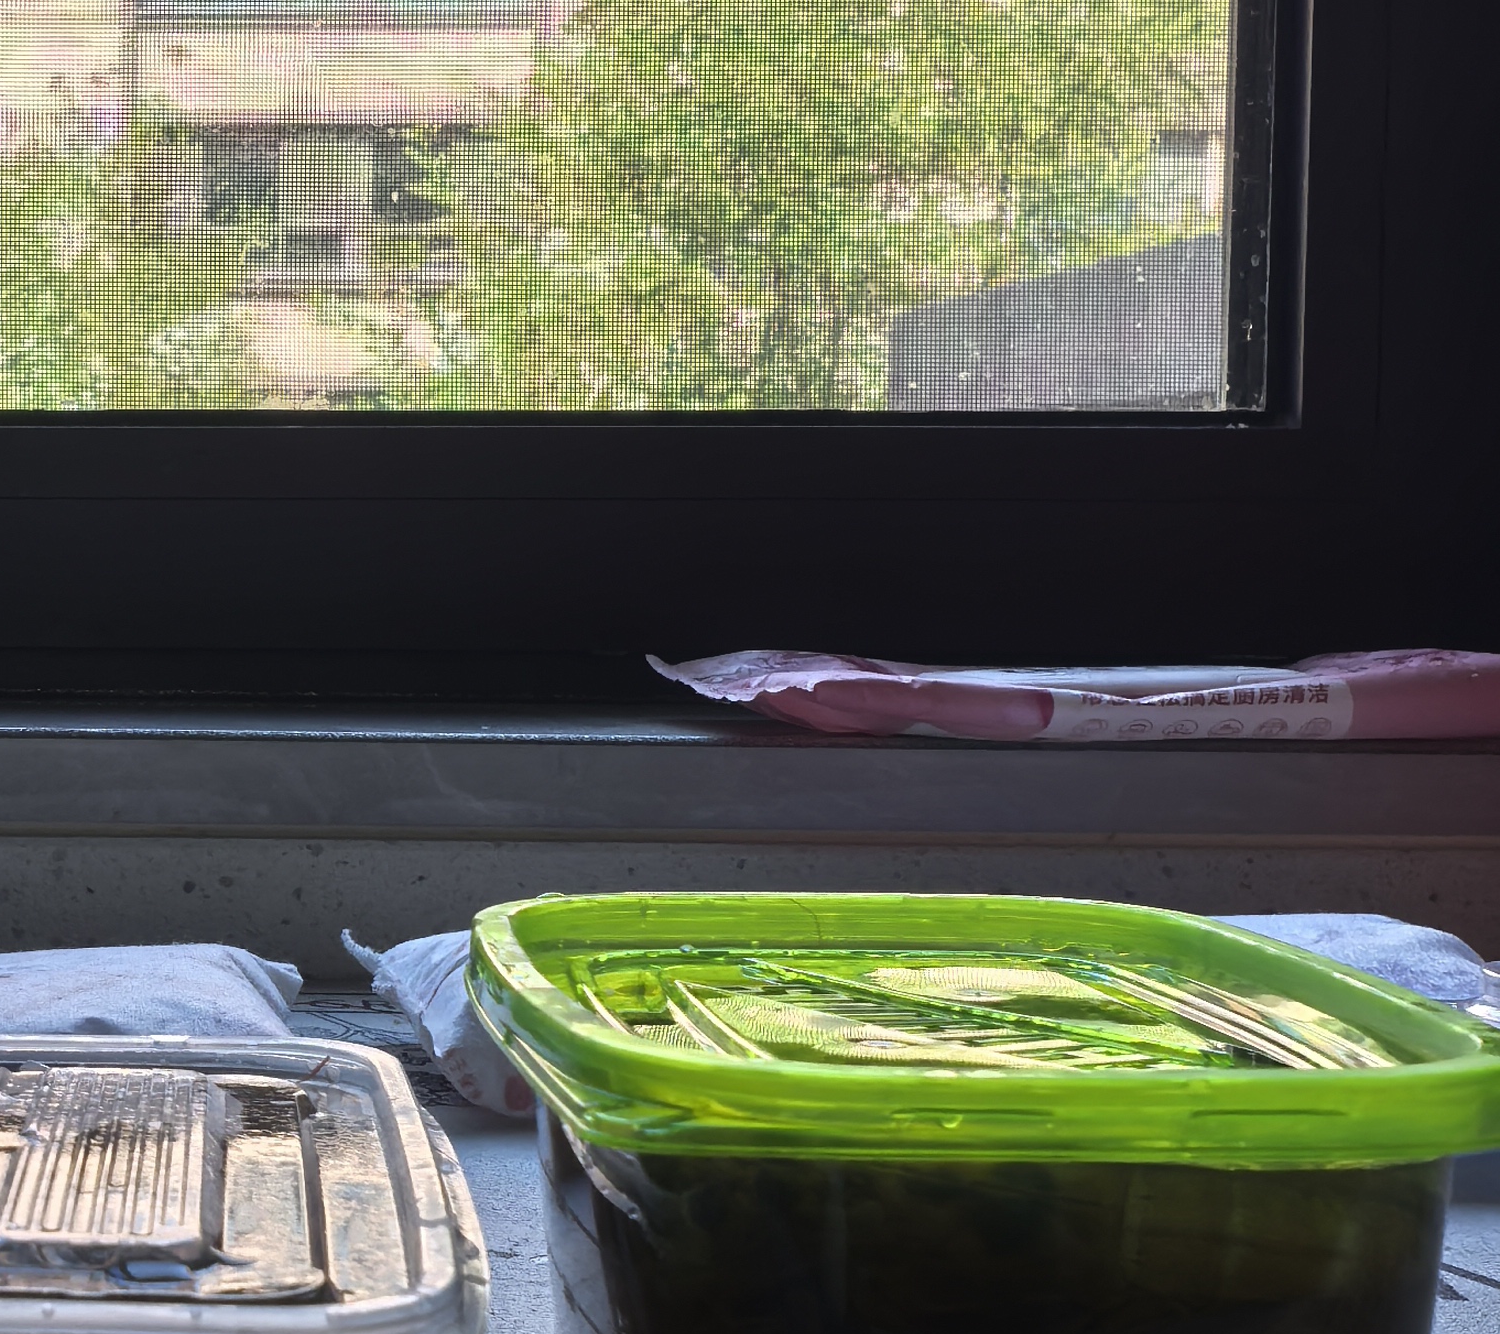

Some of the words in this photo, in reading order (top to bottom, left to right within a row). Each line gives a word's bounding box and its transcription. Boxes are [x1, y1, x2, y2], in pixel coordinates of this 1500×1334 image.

[1080, 683, 1331, 708] 松搞定厨房清洁
